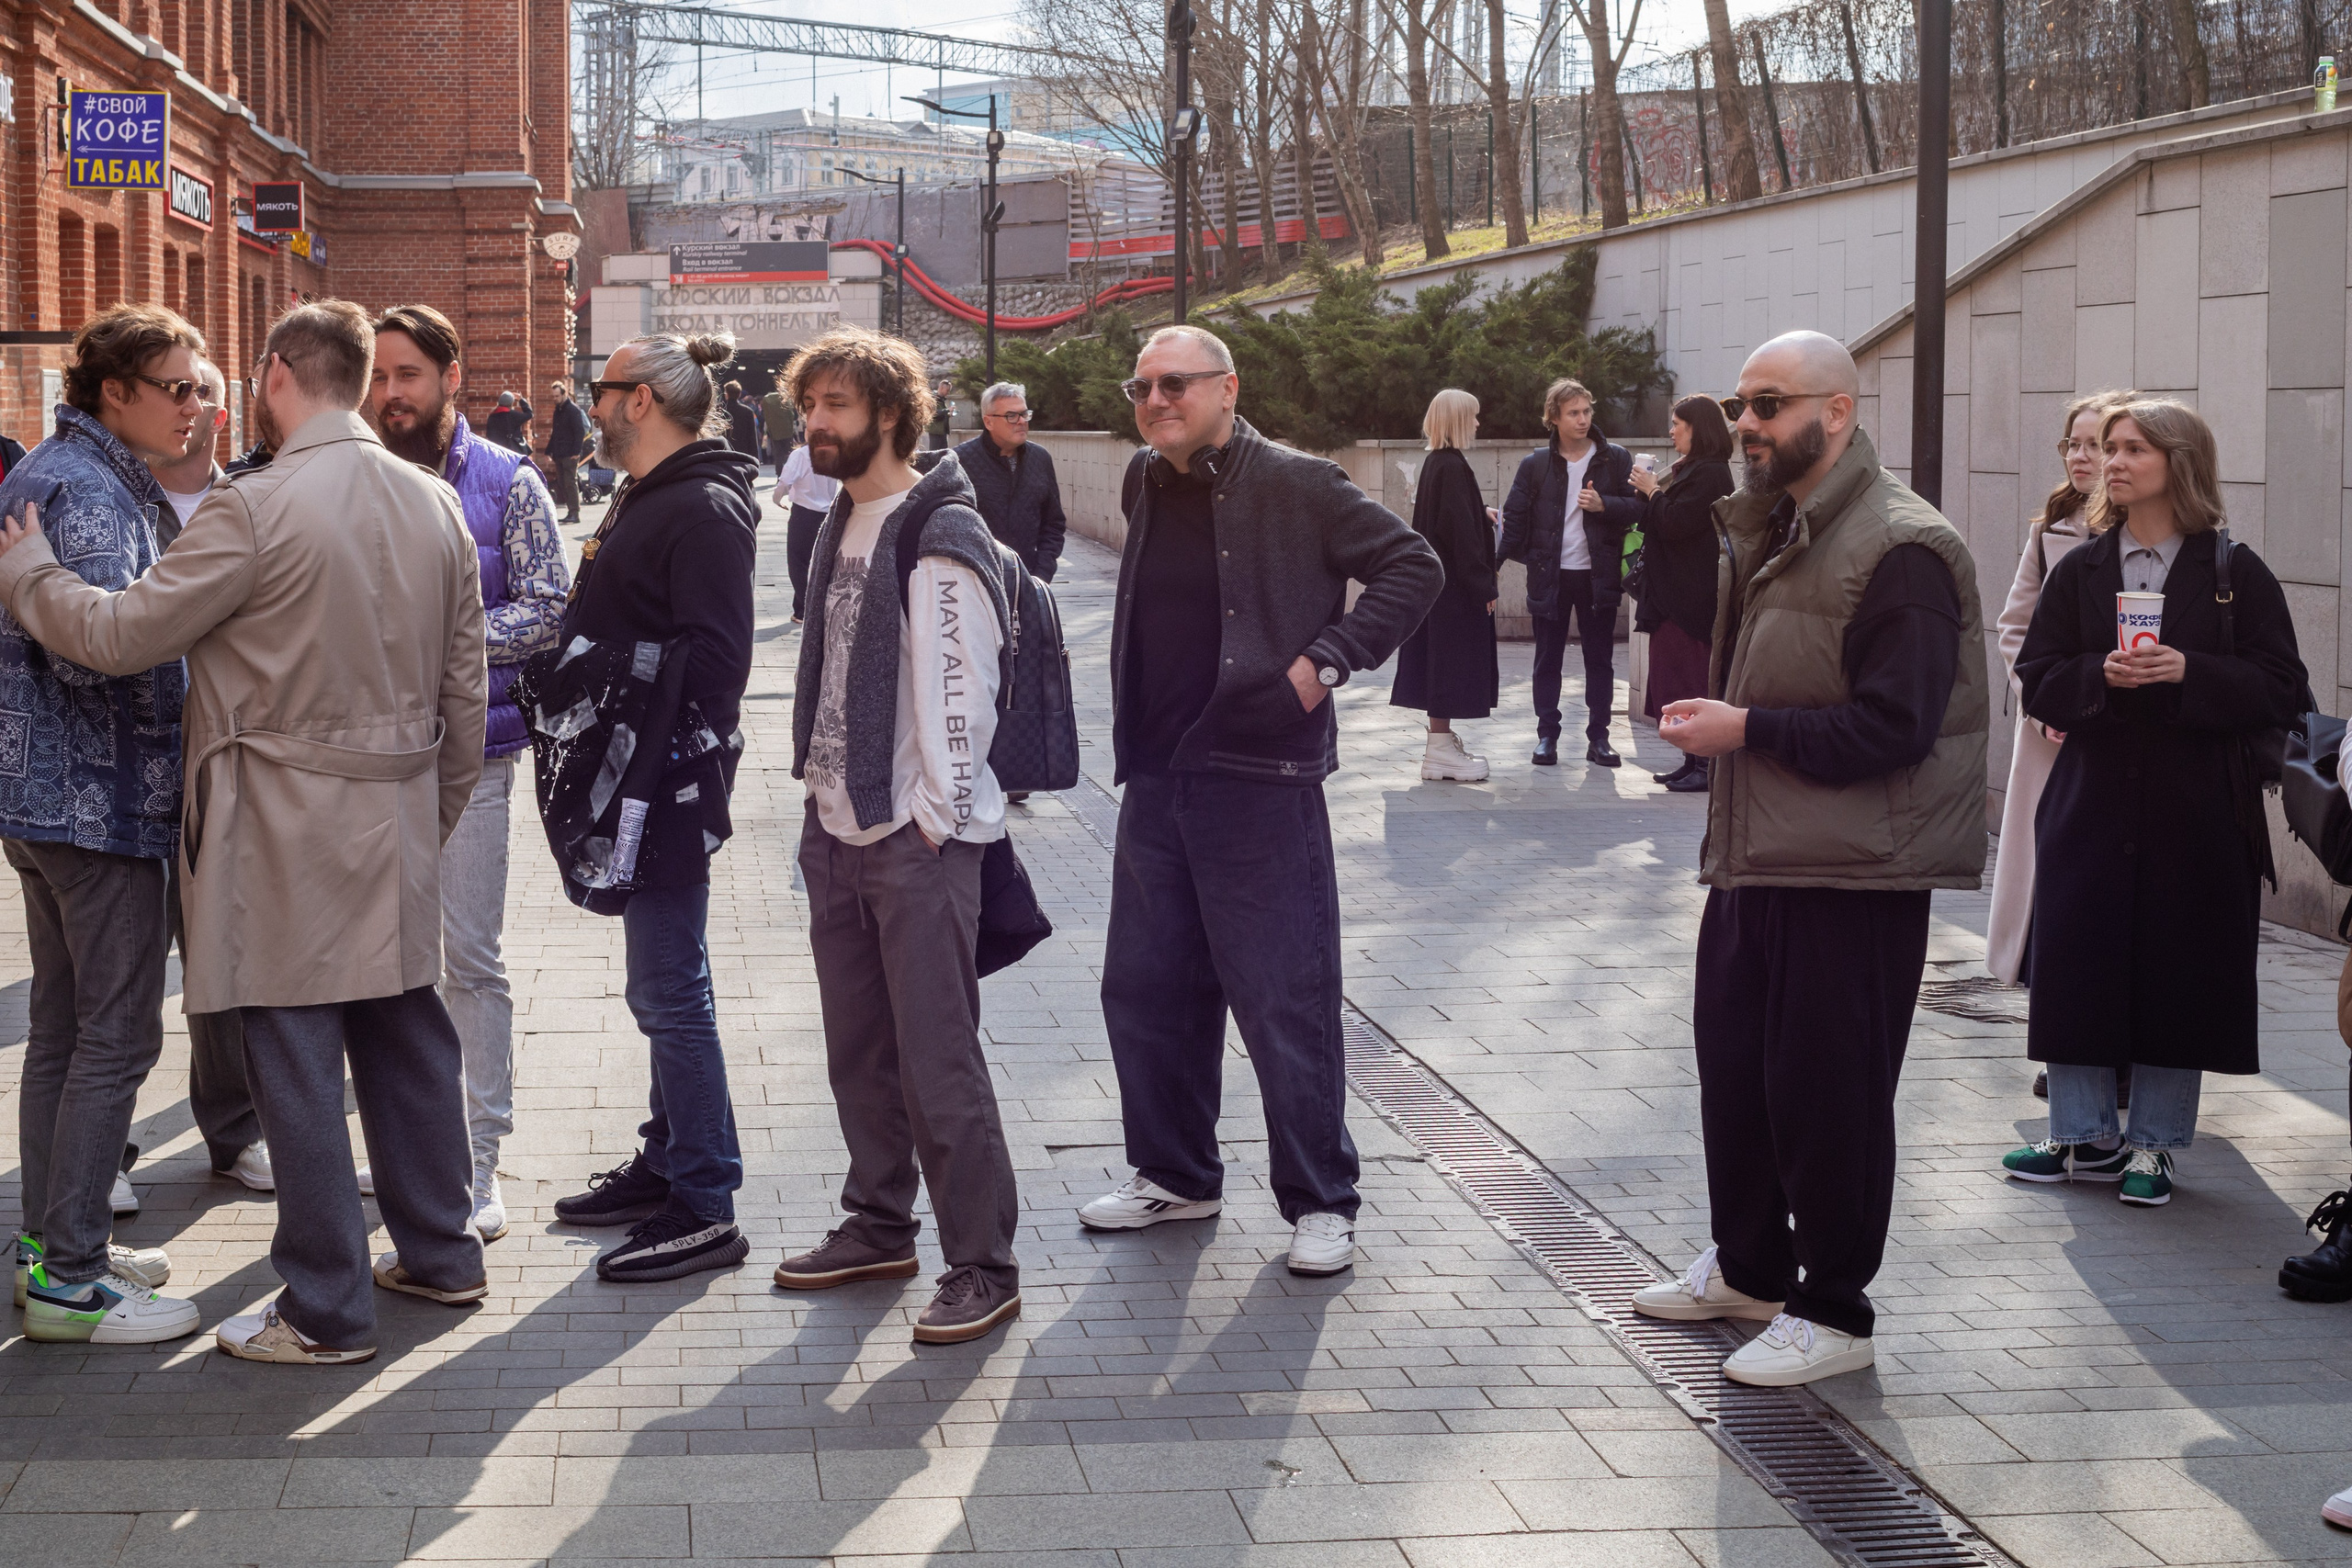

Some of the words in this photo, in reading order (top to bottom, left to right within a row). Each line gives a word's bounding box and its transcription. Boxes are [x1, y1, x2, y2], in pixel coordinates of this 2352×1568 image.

[84, 94, 147, 115] #СВОЙ
[76, 117, 162, 144] КОФЕ
[74, 158, 162, 185] ТАБАК
[172, 169, 211, 223] МЯКОТЬ
[256, 202, 299, 211] МЯКОТЬ
[548, 235, 575, 243] SURF
[682, 243, 714, 253] Курский
[763, 286, 841, 304] ВОКЗАЛ
[729, 312, 811, 331] ТОННЕЛЬ
[937, 580, 961, 645] MAY
[943, 652, 964, 707] ALL
[945, 715, 969, 753] BE
[805, 768, 837, 790] MIND
[672, 1227, 720, 1248] SPLY-350
